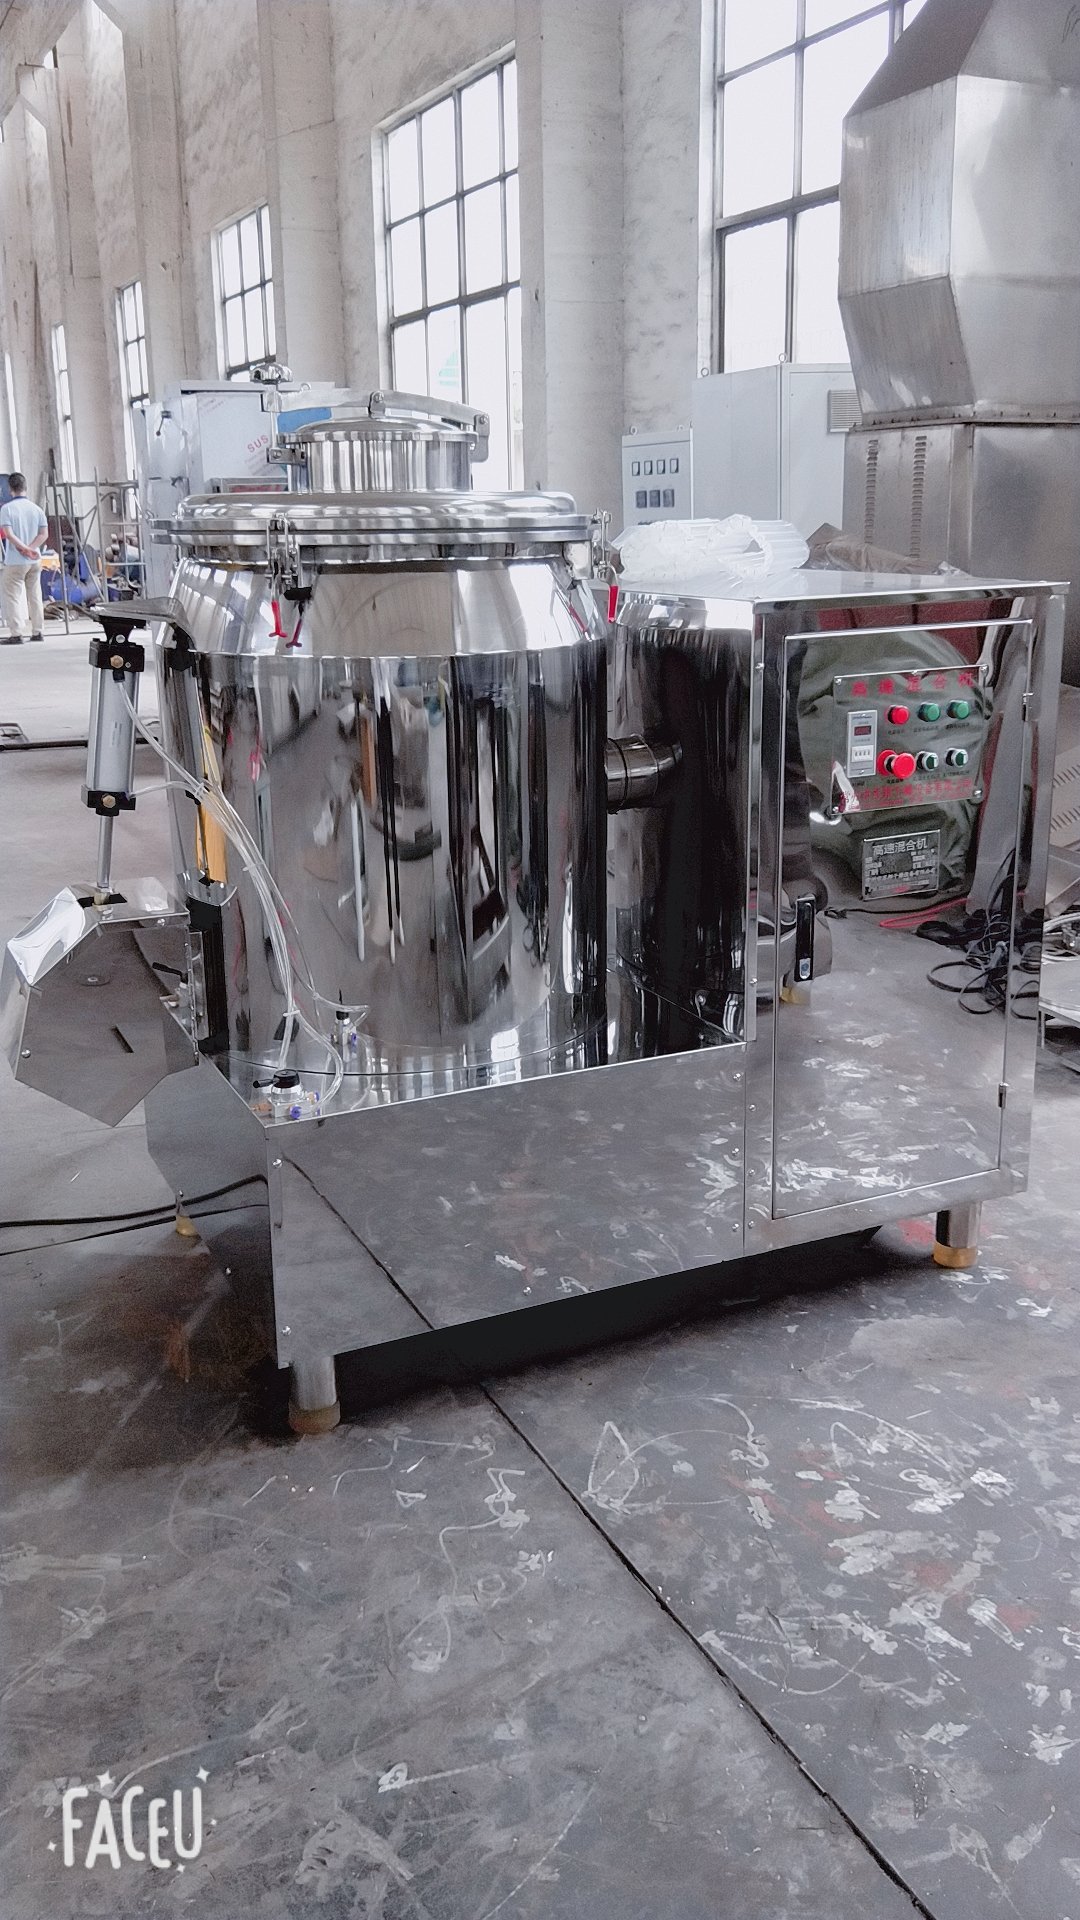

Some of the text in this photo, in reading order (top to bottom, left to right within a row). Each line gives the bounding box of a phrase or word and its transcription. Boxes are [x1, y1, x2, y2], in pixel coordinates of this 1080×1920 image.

[247, 434, 269, 453] SUS
[872, 838, 928, 856] 高速混合机
